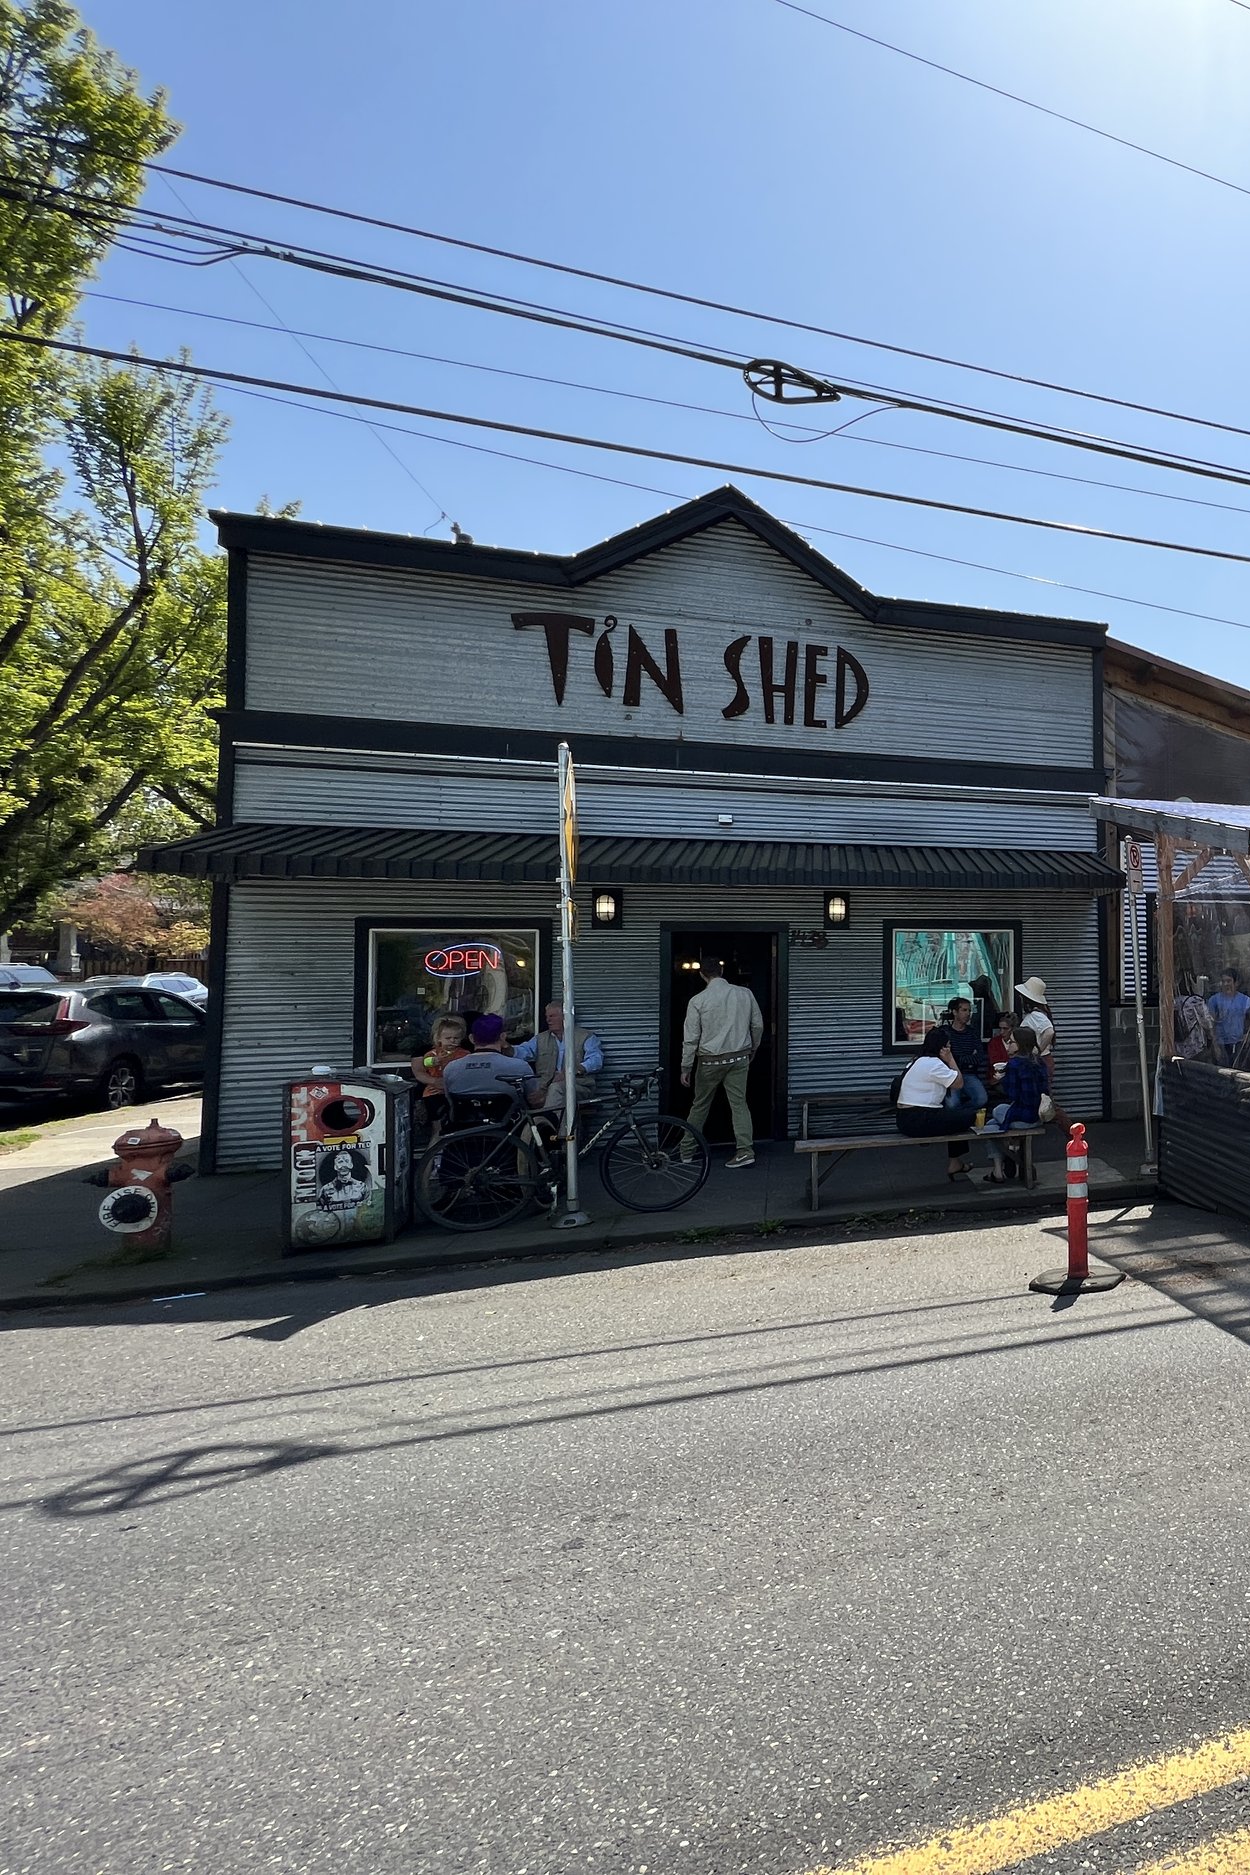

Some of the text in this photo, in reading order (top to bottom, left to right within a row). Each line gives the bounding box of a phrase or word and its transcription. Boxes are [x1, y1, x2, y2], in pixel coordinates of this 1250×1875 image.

[721, 635, 870, 729] SHED
[424, 950, 498, 970] OPEN
[322, 1144, 341, 1152] VOTE
[111, 1187, 142, 1200] USE
[103, 1204, 120, 1228] FIRE
